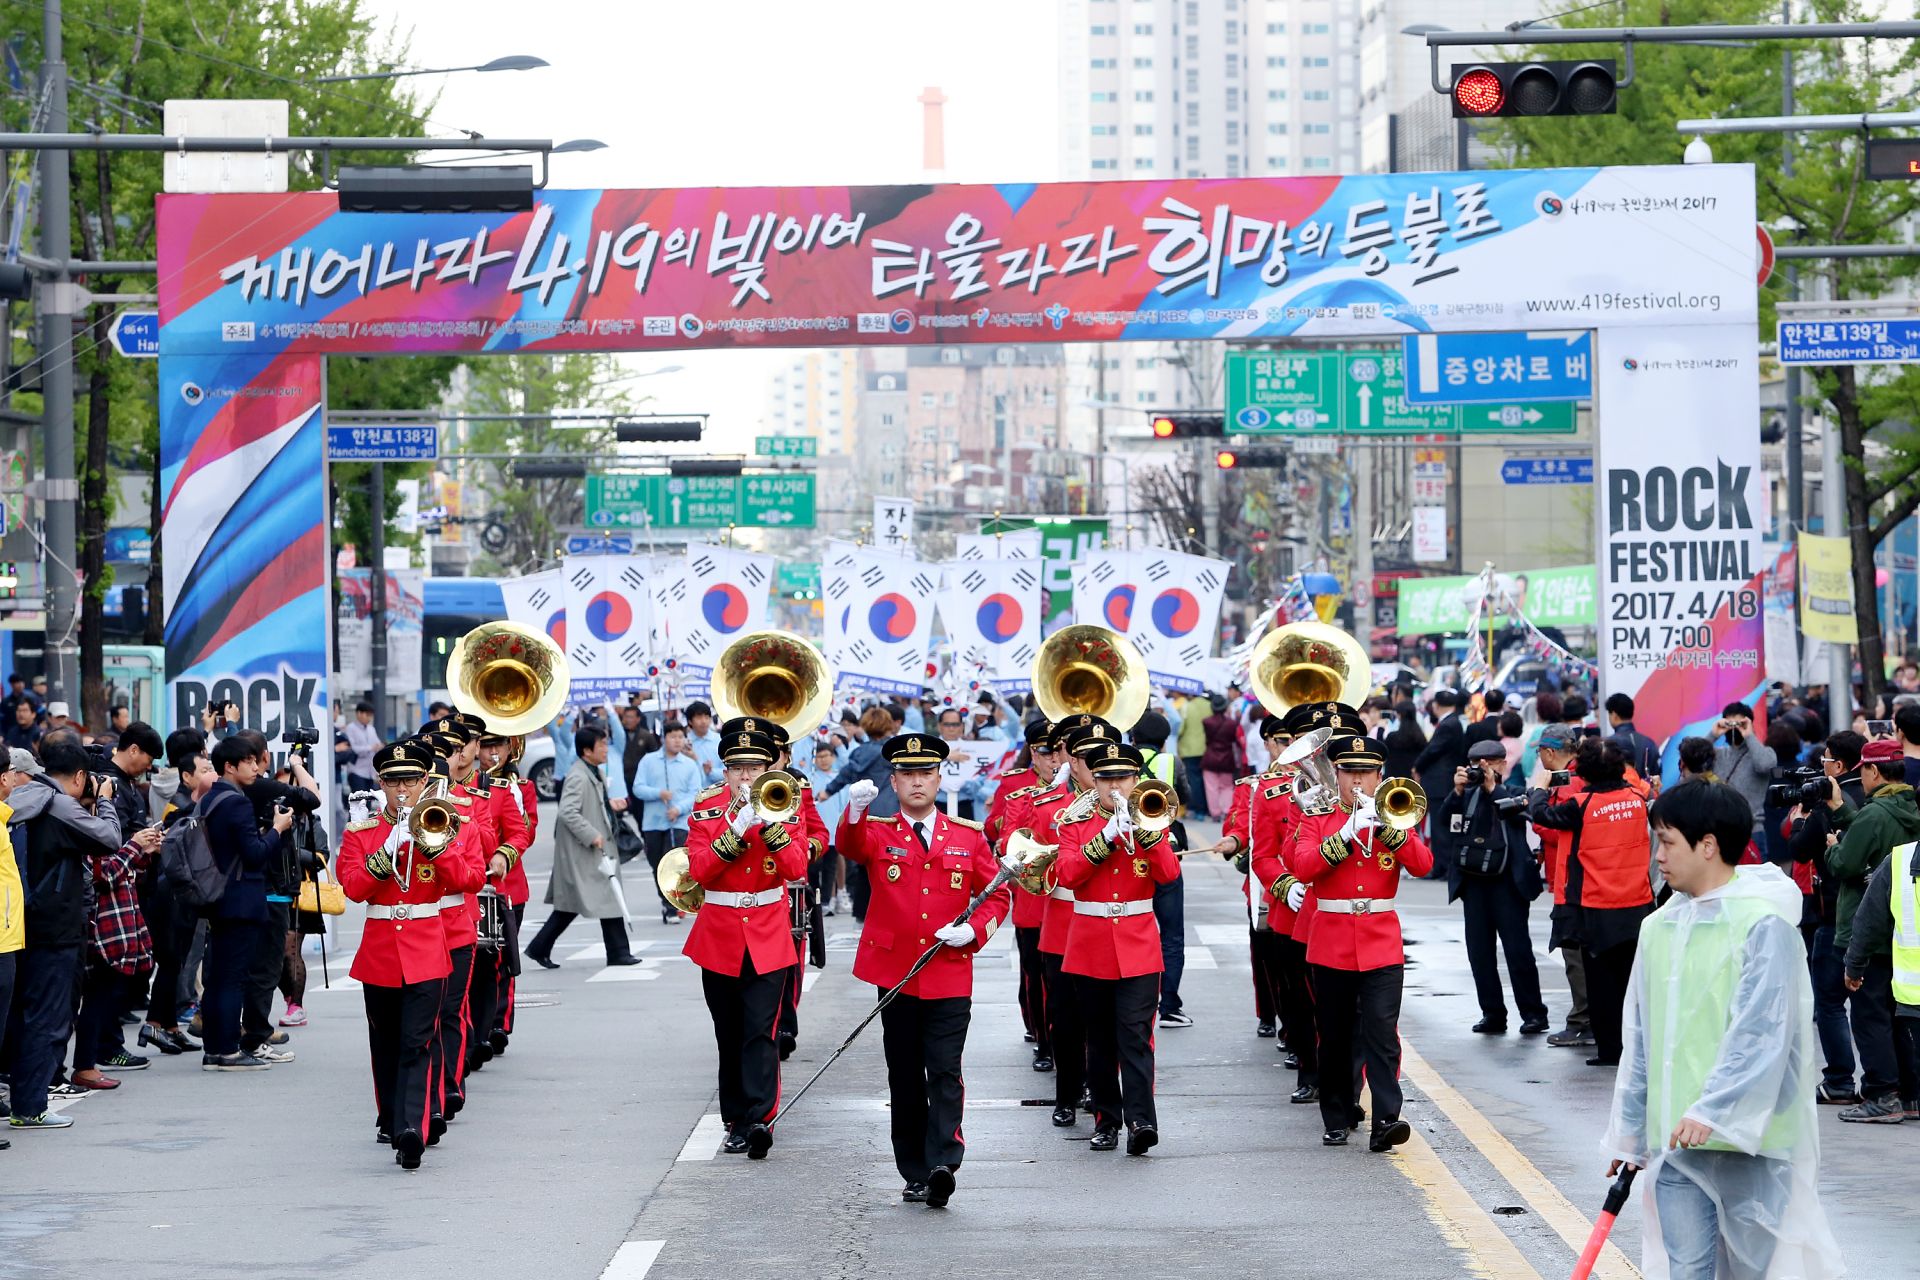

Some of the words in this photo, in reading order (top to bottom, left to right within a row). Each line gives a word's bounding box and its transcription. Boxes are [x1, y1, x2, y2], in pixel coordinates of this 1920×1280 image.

[1682, 196, 1716, 210] 2017
[220, 225, 513, 304] 깨어나라
[707, 209, 866, 308] 빛이여
[871, 212, 1139, 299] 타올라라
[1143, 197, 1331, 298] 희망의
[1339, 182, 1502, 286] 등불로
[1527, 291, 1720, 311] www.419festival.org
[861, 315, 885, 330] 후원
[1160, 311, 1188, 323] KBS
[1286, 307, 1339, 319] 동아일보
[1353, 305, 1376, 319] 협찬
[226, 325, 251, 338] 주최
[647, 320, 671, 332] 주관
[1784, 322, 1888, 345] 한천로139길
[1784, 347, 1869, 361] Hancheon-ro
[1873, 344, 1917, 360] 139-gil
[1255, 358, 1309, 377] 의정부
[1444, 356, 1552, 386] 중앙차로
[1566, 354, 1587, 382] 버
[1715, 359, 1738, 368] 2017
[352, 429, 434, 446] 한천로138길
[328, 447, 396, 458] Hancheon-ro
[1609, 456, 1753, 537] ROCK
[1609, 539, 1755, 583] FESTIVAL
[1613, 627, 1650, 649] PM
[1662, 625, 1712, 649] 7:00
[1612, 653, 1666, 670] 강북구청
[1670, 650, 1712, 668] 사거리
[1715, 650, 1757, 668] 수유역
